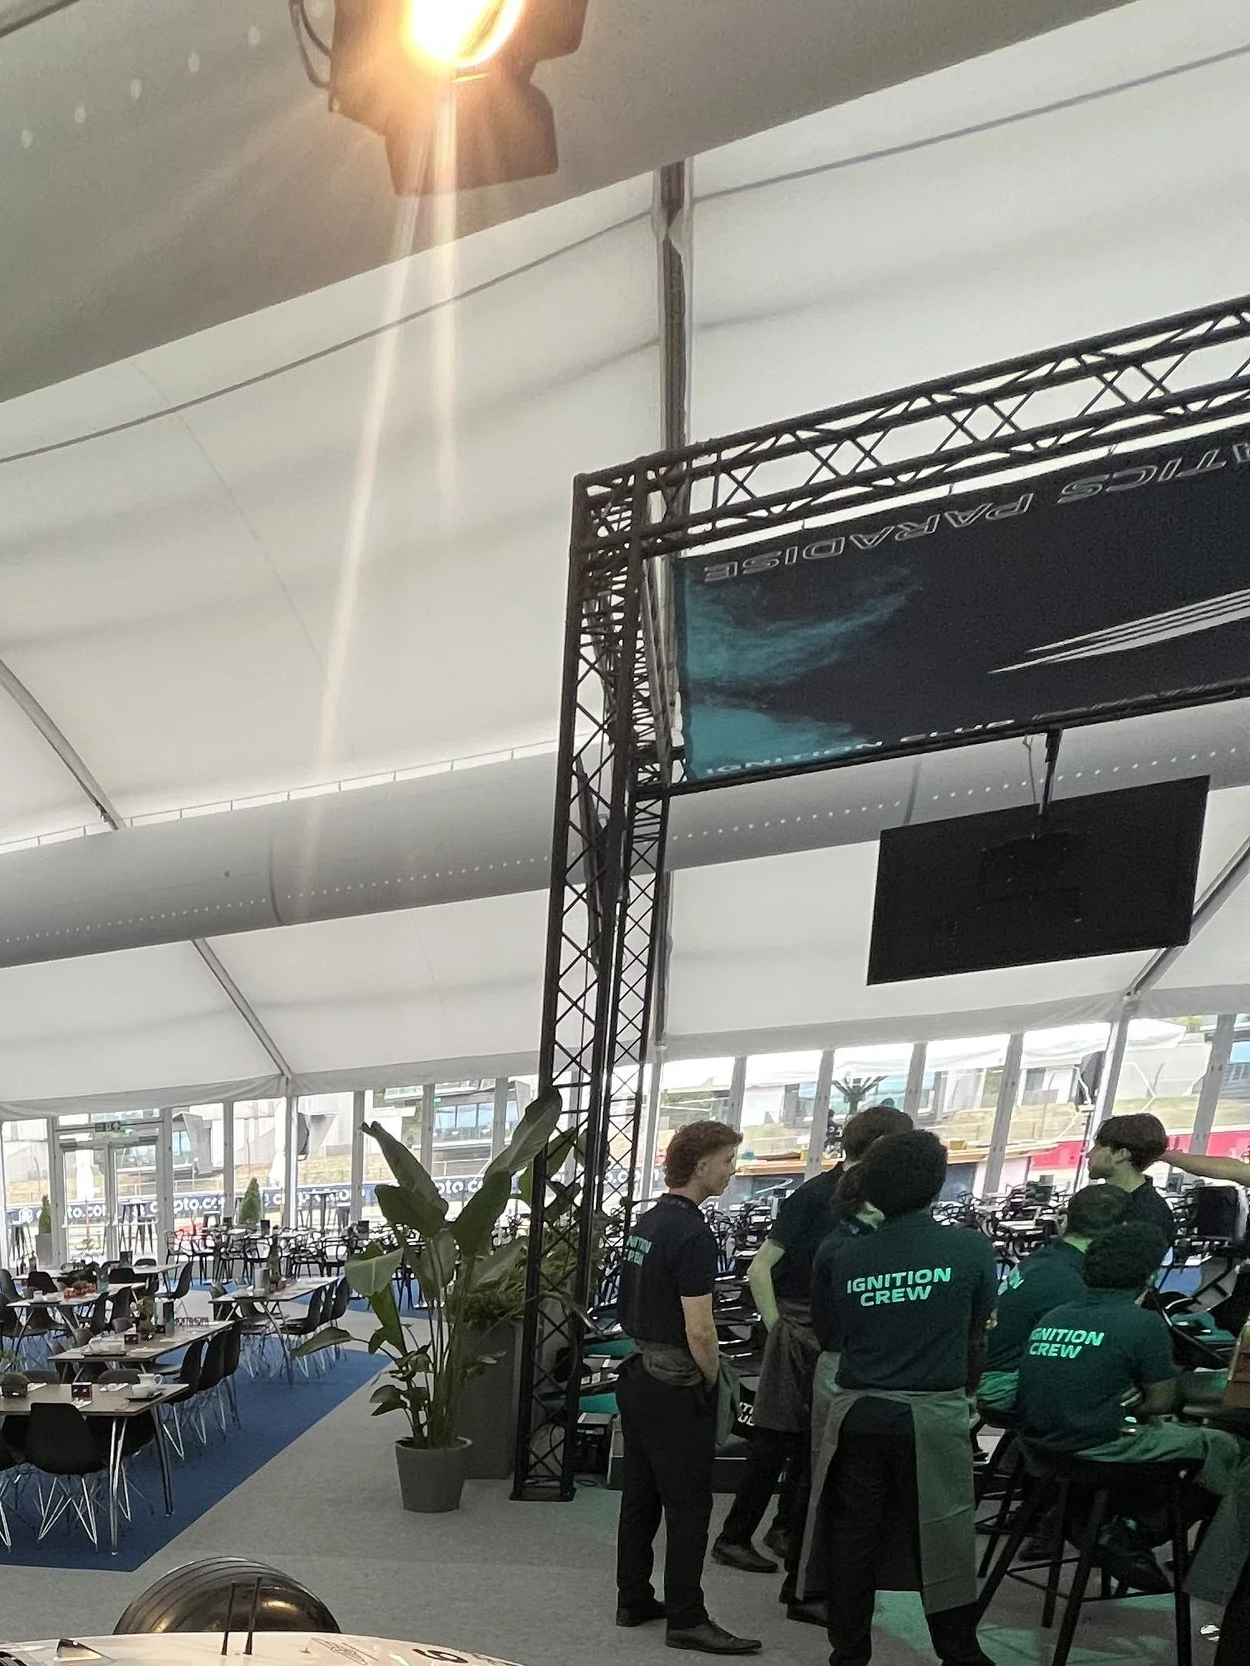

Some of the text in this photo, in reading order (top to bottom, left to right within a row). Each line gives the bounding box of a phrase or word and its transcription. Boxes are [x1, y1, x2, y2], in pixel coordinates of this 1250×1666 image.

[703, 493, 1034, 582] PARADISE
[847, 1268, 951, 1293] IGNITION
[860, 1286, 931, 1307] CREW
[1030, 1343, 1082, 1358] CREW
